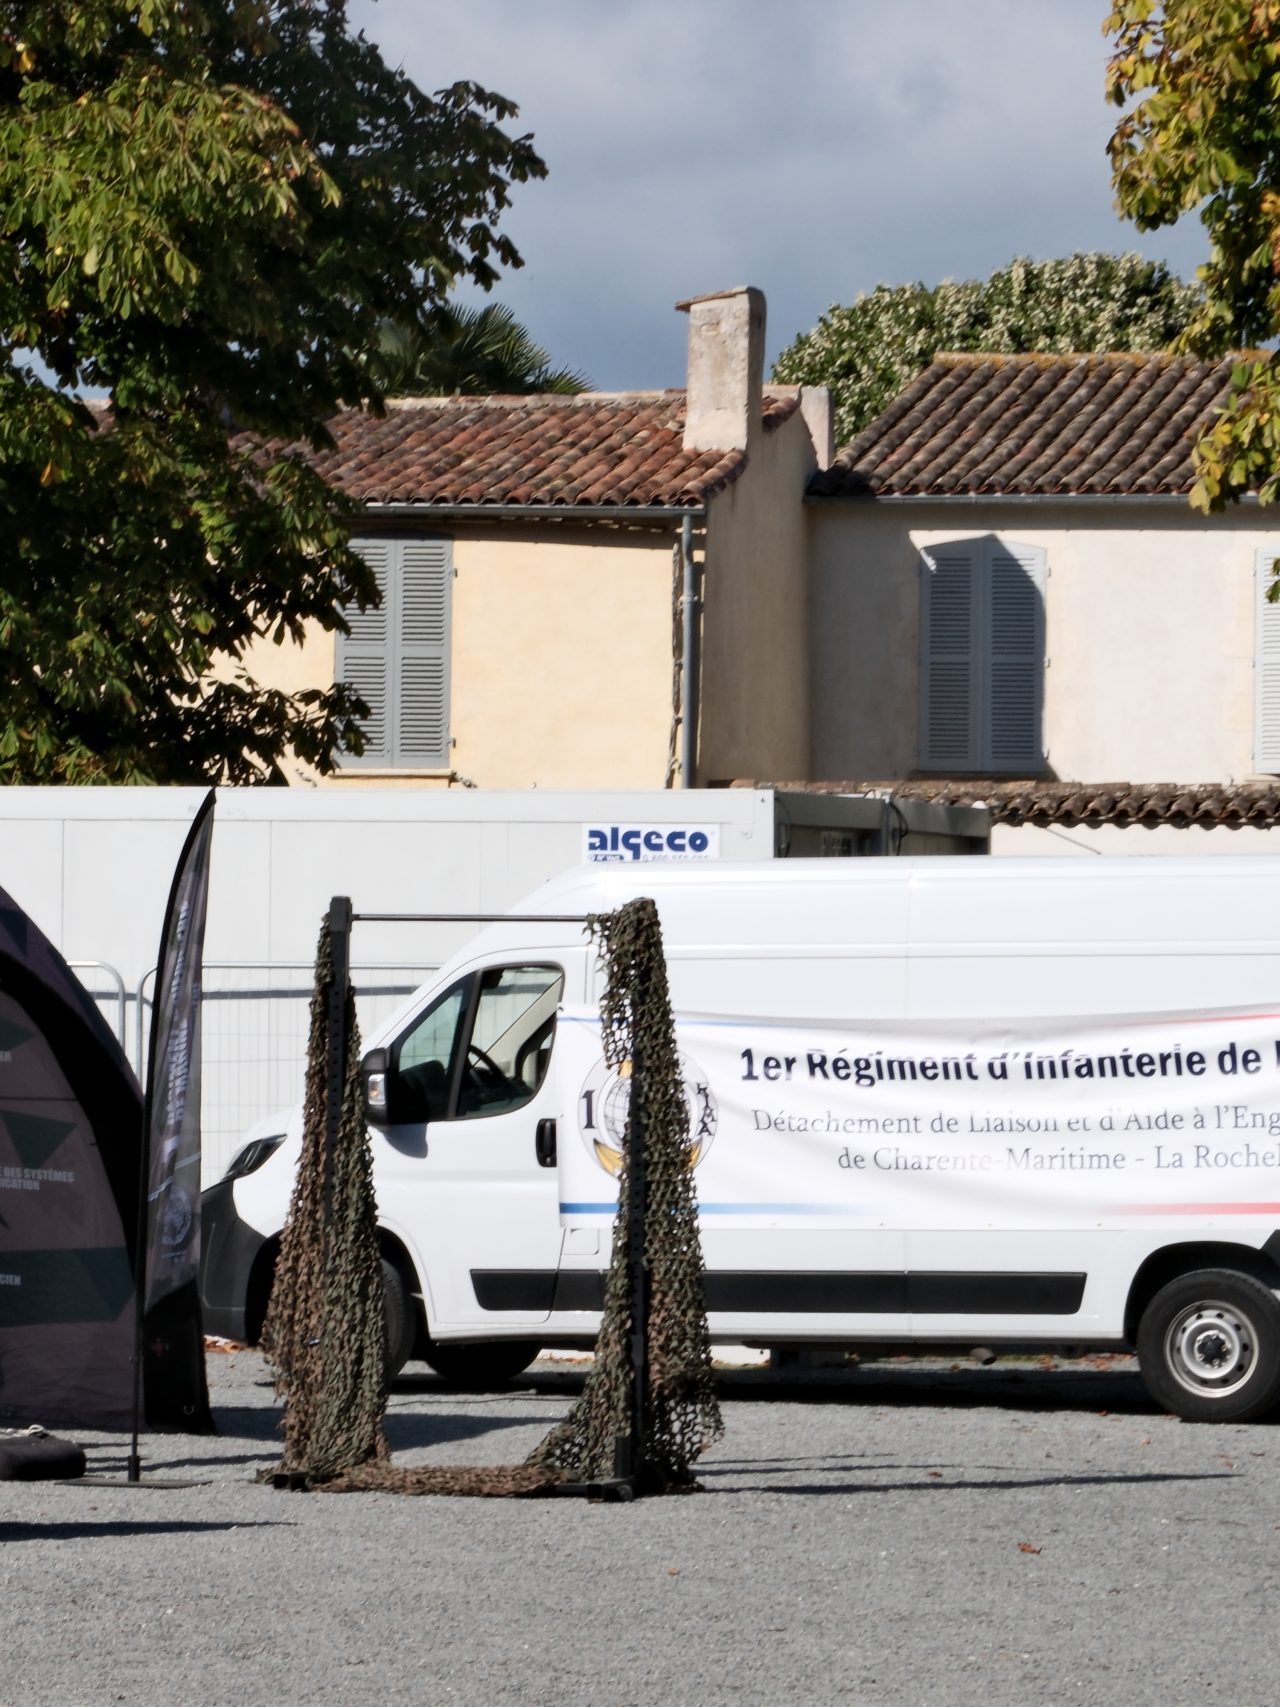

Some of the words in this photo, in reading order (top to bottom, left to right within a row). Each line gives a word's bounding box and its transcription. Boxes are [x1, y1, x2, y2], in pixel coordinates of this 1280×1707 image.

[588, 826, 709, 860] algeco
[741, 1048, 796, 1081] 1er
[807, 1048, 979, 1087] Régiment
[988, 1043, 1206, 1080] d'infanterie
[1218, 1042, 1261, 1075] de
[582, 1089, 596, 1130] 1
[752, 1109, 921, 1134] Détachement
[930, 1111, 959, 1133] de
[969, 1110, 1058, 1133] Liaison
[1067, 1113, 1090, 1131] et
[1193, 1107, 1205, 1129] à
[839, 1146, 865, 1169] de
[873, 1146, 1125, 1170] Charente-Maritime
[1155, 1146, 1183, 1168] La
[4, 1166, 21, 1178] DES
[24, 1168, 74, 1183] SYSTÈMES
